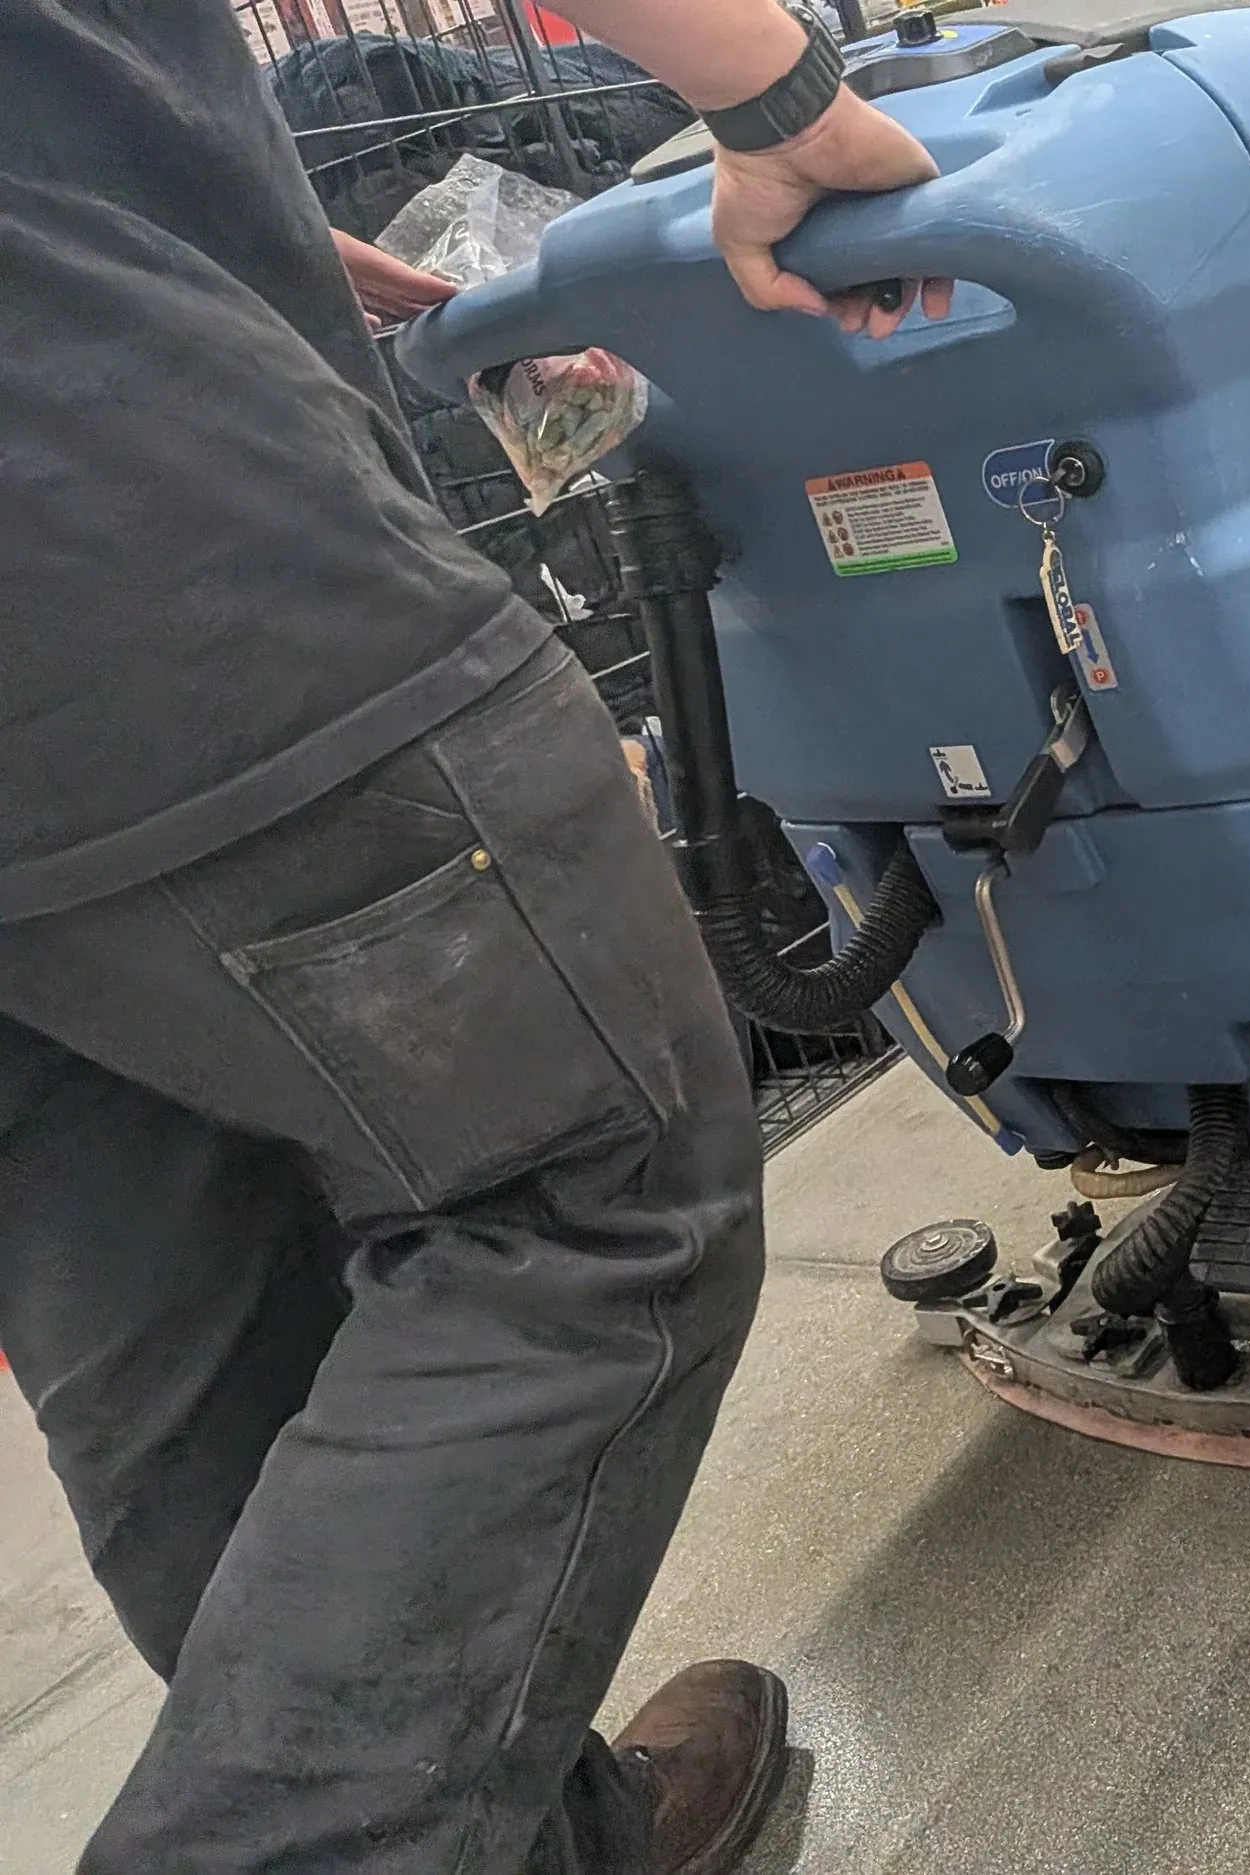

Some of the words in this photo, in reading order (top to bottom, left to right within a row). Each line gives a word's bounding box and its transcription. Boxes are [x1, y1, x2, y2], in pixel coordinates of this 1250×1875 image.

[834, 469, 896, 488] WARNING
[991, 467, 1043, 489] OFF/ON
[1051, 563, 1081, 647] GLOBAL
